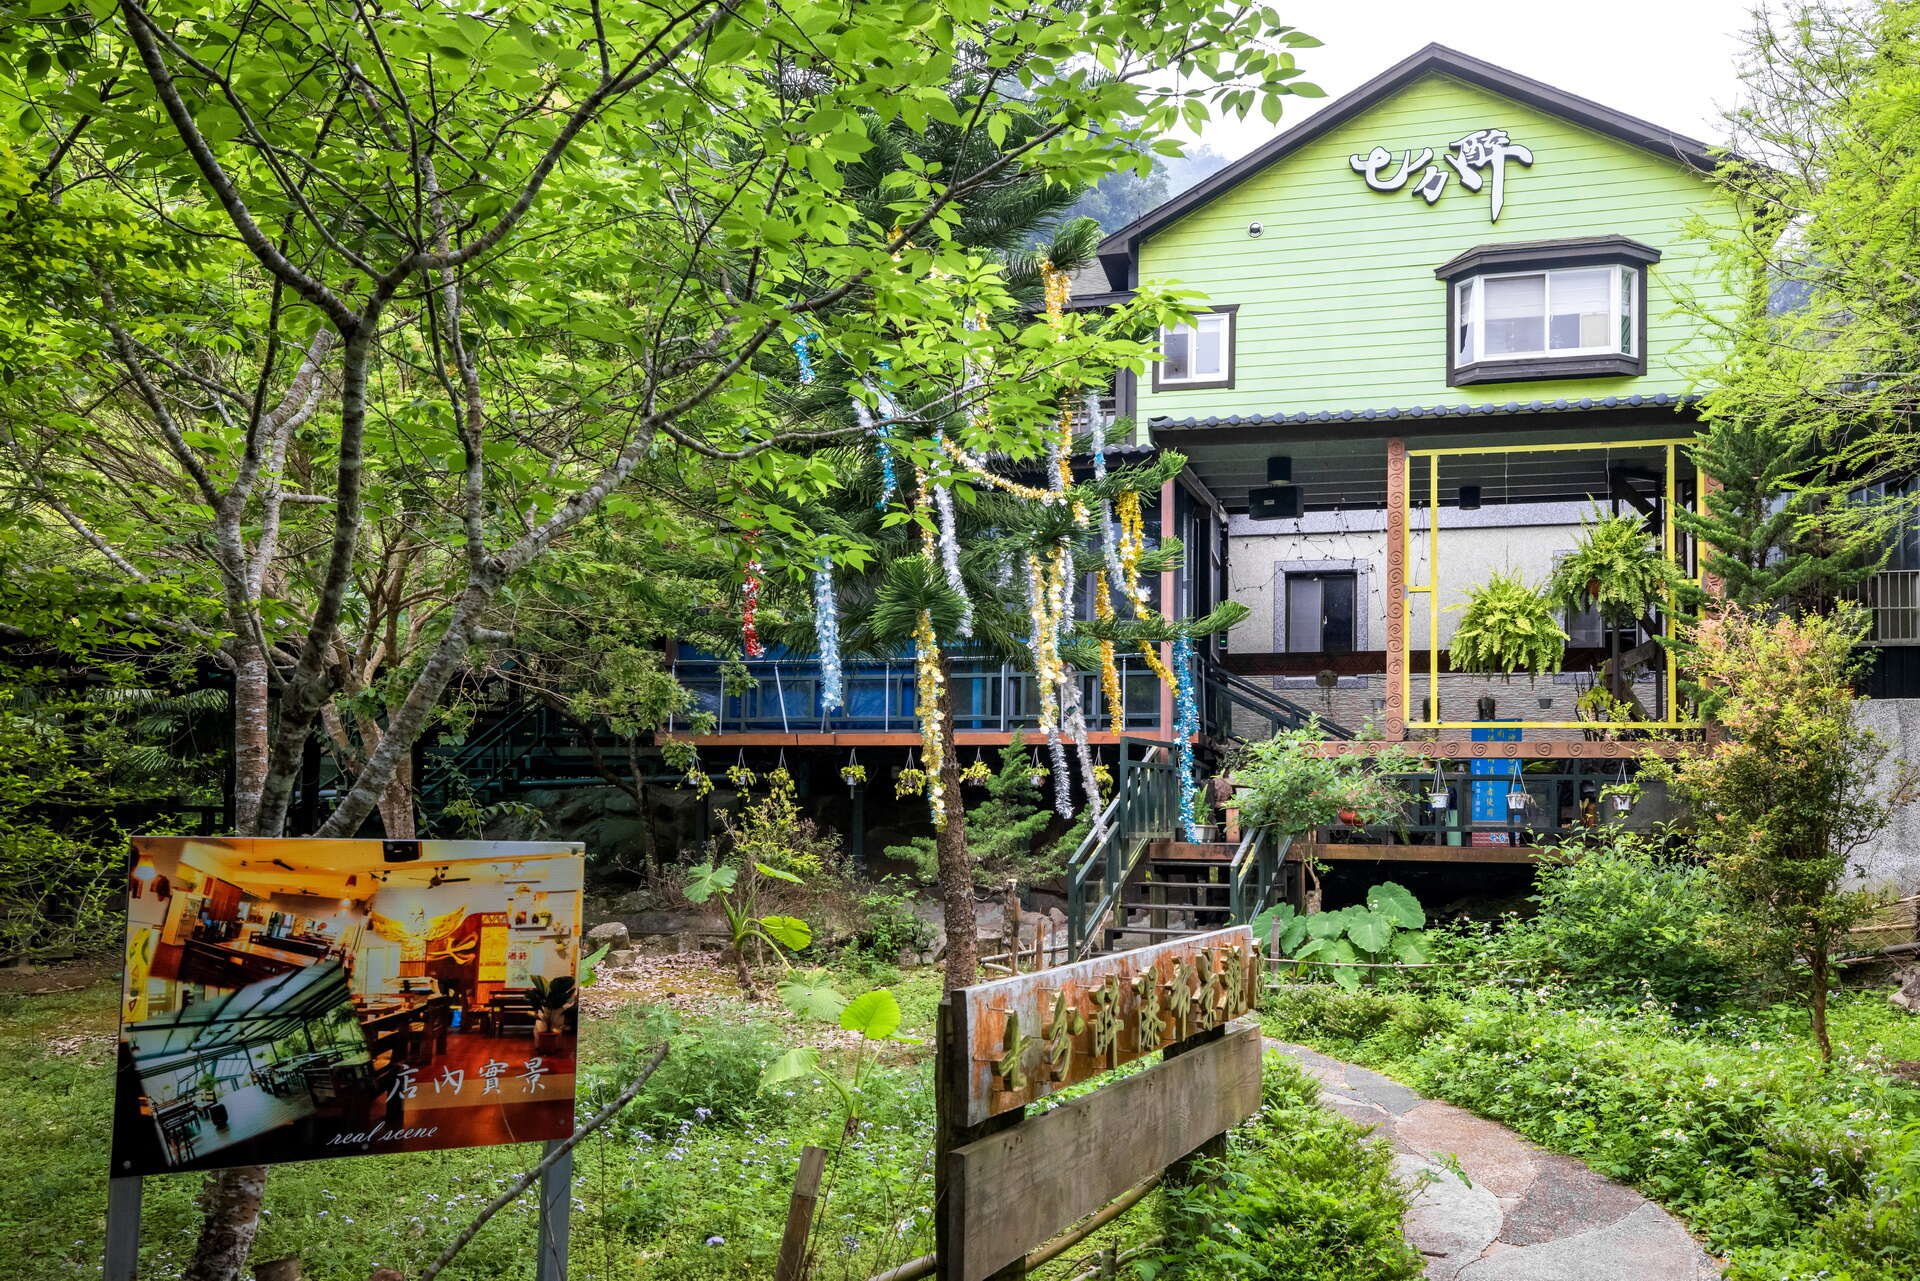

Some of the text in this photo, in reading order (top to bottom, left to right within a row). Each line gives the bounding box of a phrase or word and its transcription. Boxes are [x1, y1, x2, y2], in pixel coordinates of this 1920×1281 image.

[385, 1057, 549, 1103] 店內實景
[326, 1121, 438, 1146] real scene
